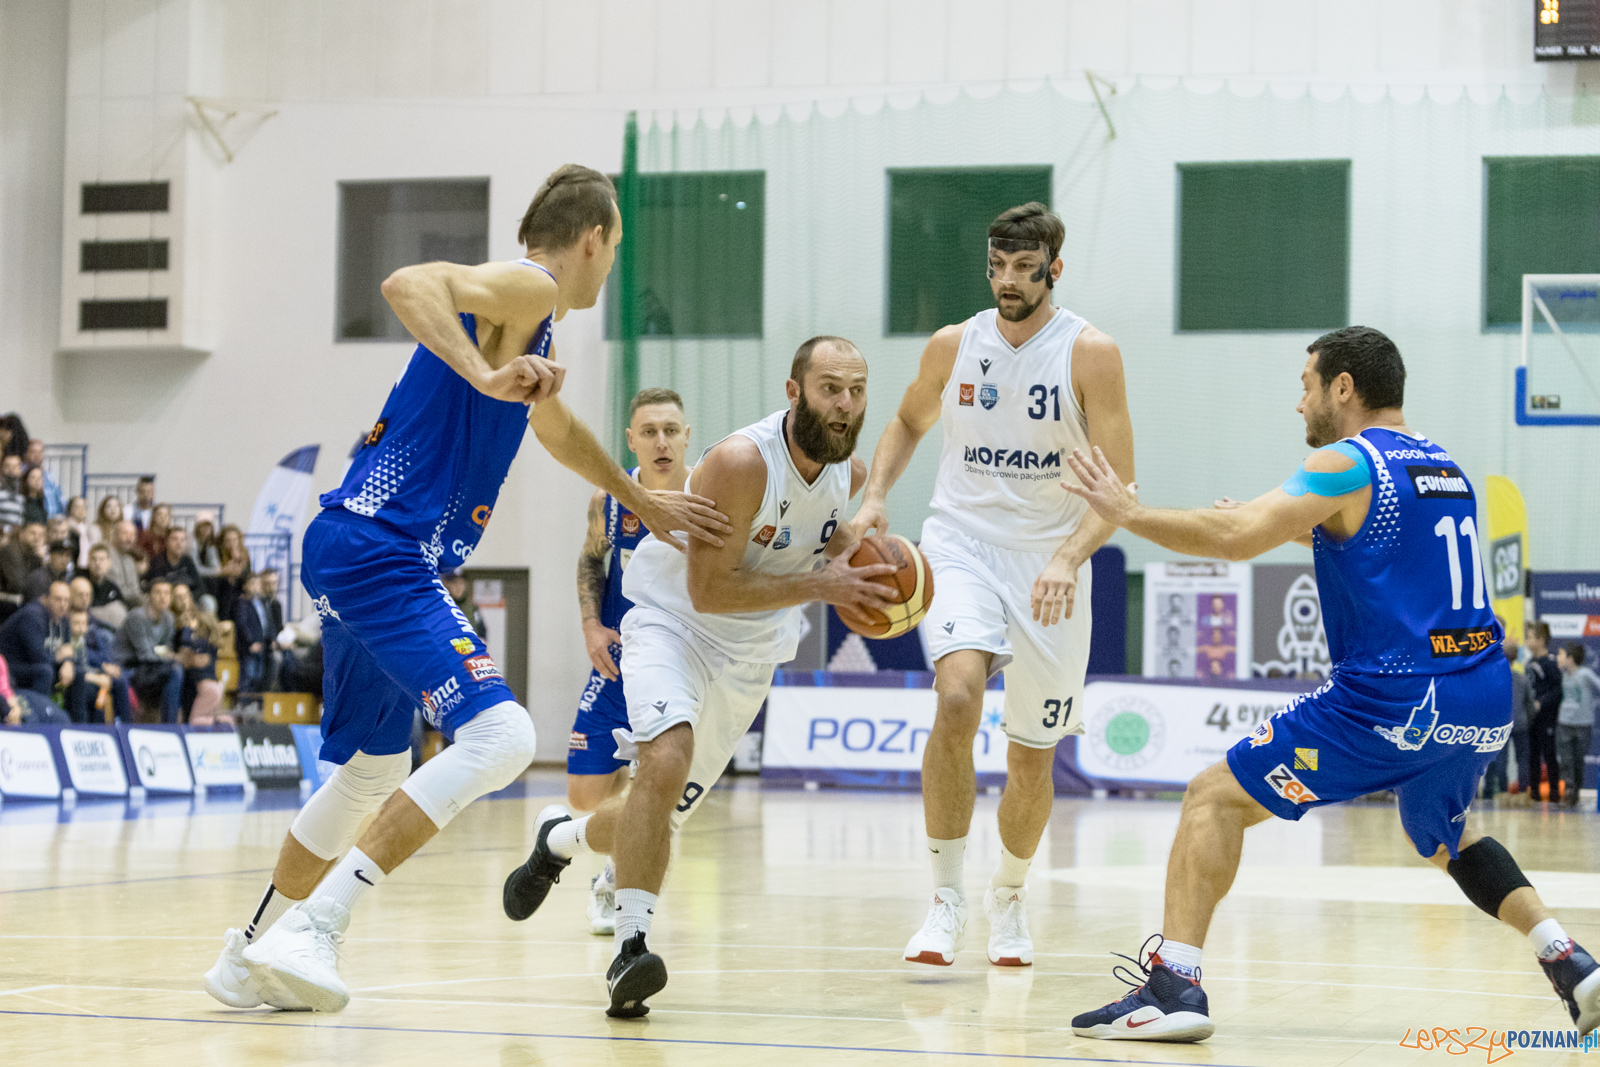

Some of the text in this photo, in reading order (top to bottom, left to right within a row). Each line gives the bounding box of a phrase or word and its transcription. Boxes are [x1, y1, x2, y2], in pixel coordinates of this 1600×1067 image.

[1028, 384, 1061, 421] 31
[1020, 471, 1061, 481] pacjentów
[813, 519, 838, 555] 9
[1434, 516, 1485, 610] 11
[1042, 696, 1073, 729] 31
[1206, 703, 1232, 733] 4
[676, 781, 704, 813] 9
